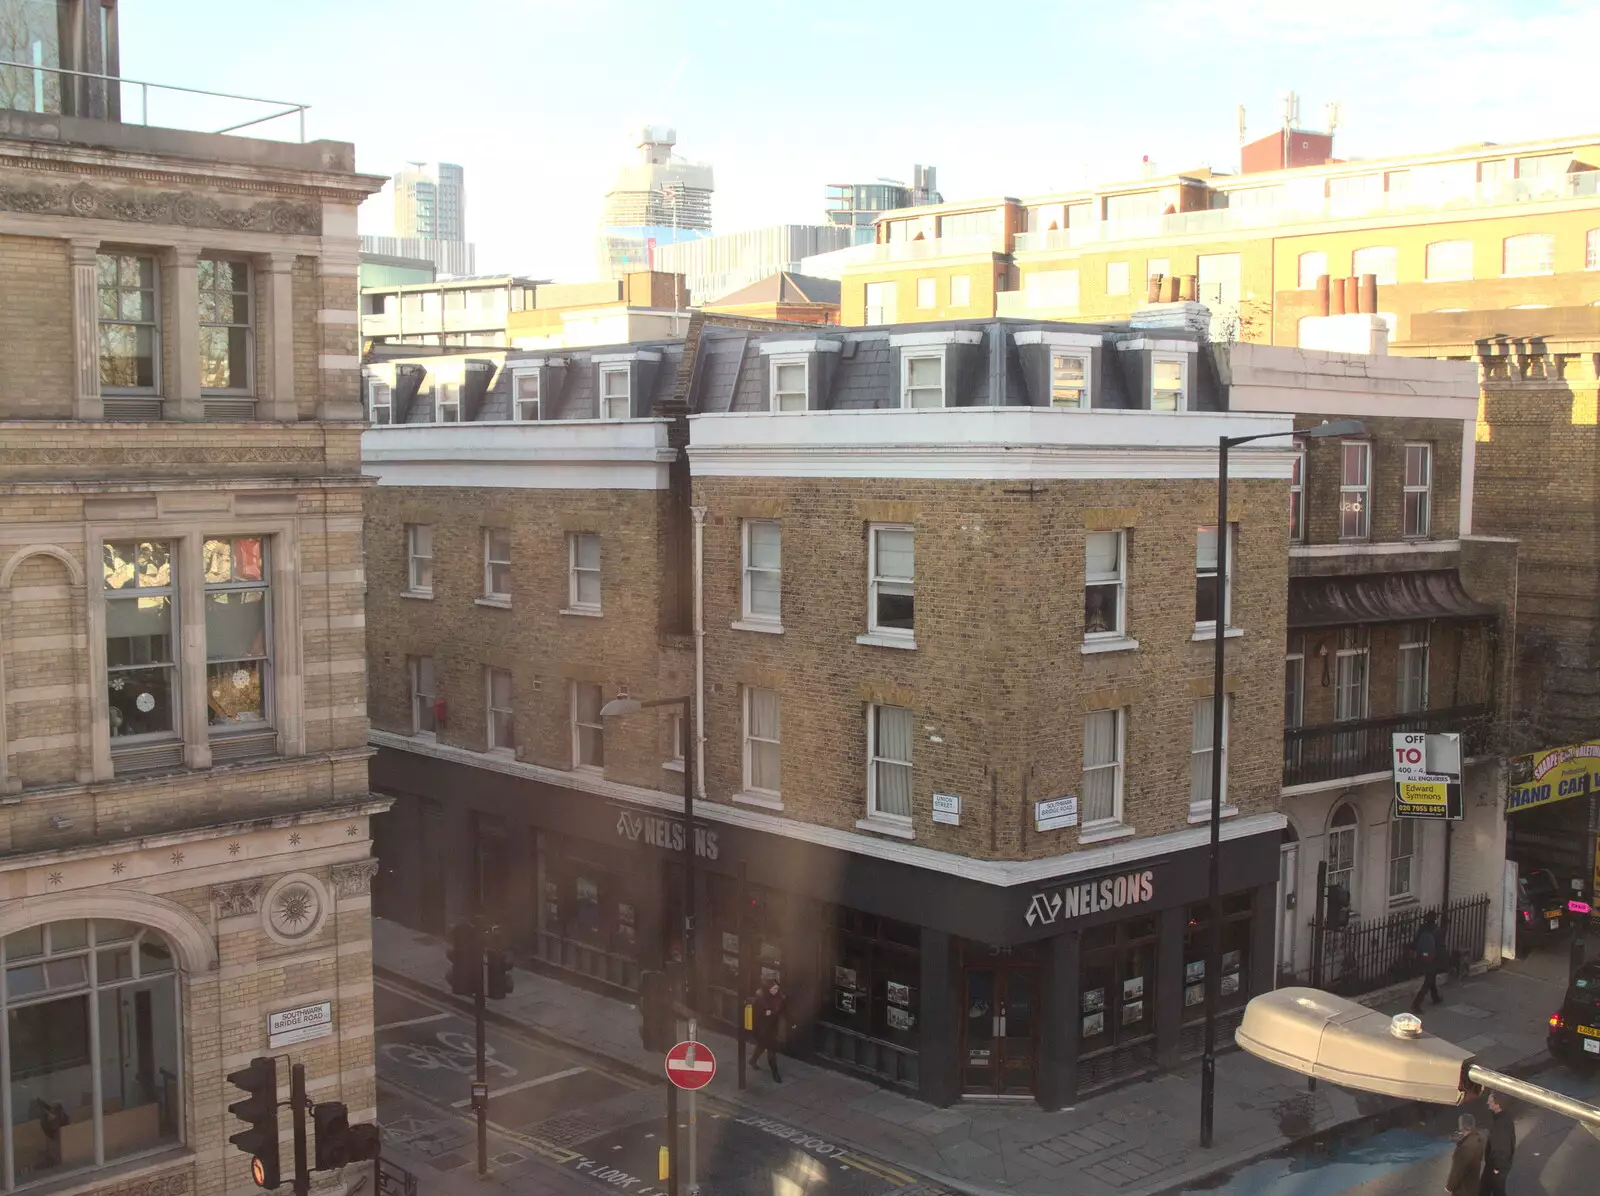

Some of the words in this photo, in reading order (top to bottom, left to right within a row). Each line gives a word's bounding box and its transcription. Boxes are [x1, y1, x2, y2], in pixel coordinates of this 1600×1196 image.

[1404, 735, 1425, 744] OFF
[1396, 748, 1422, 764] TO
[1406, 784, 1434, 793] Edward
[1406, 792, 1442, 801] Symmons
[1510, 783, 1551, 808] HAND
[934, 800, 953, 809] STREET
[644, 816, 719, 860] NELSNS
[1065, 871, 1153, 919] NELSONS
[274, 1016, 302, 1028] BRIDGE
[303, 1012, 324, 1022] ROAD
[282, 1006, 322, 1020] SOUTHWARK
[789, 1133, 849, 1159] LOOK
[588, 1165, 641, 1188] LOOK
